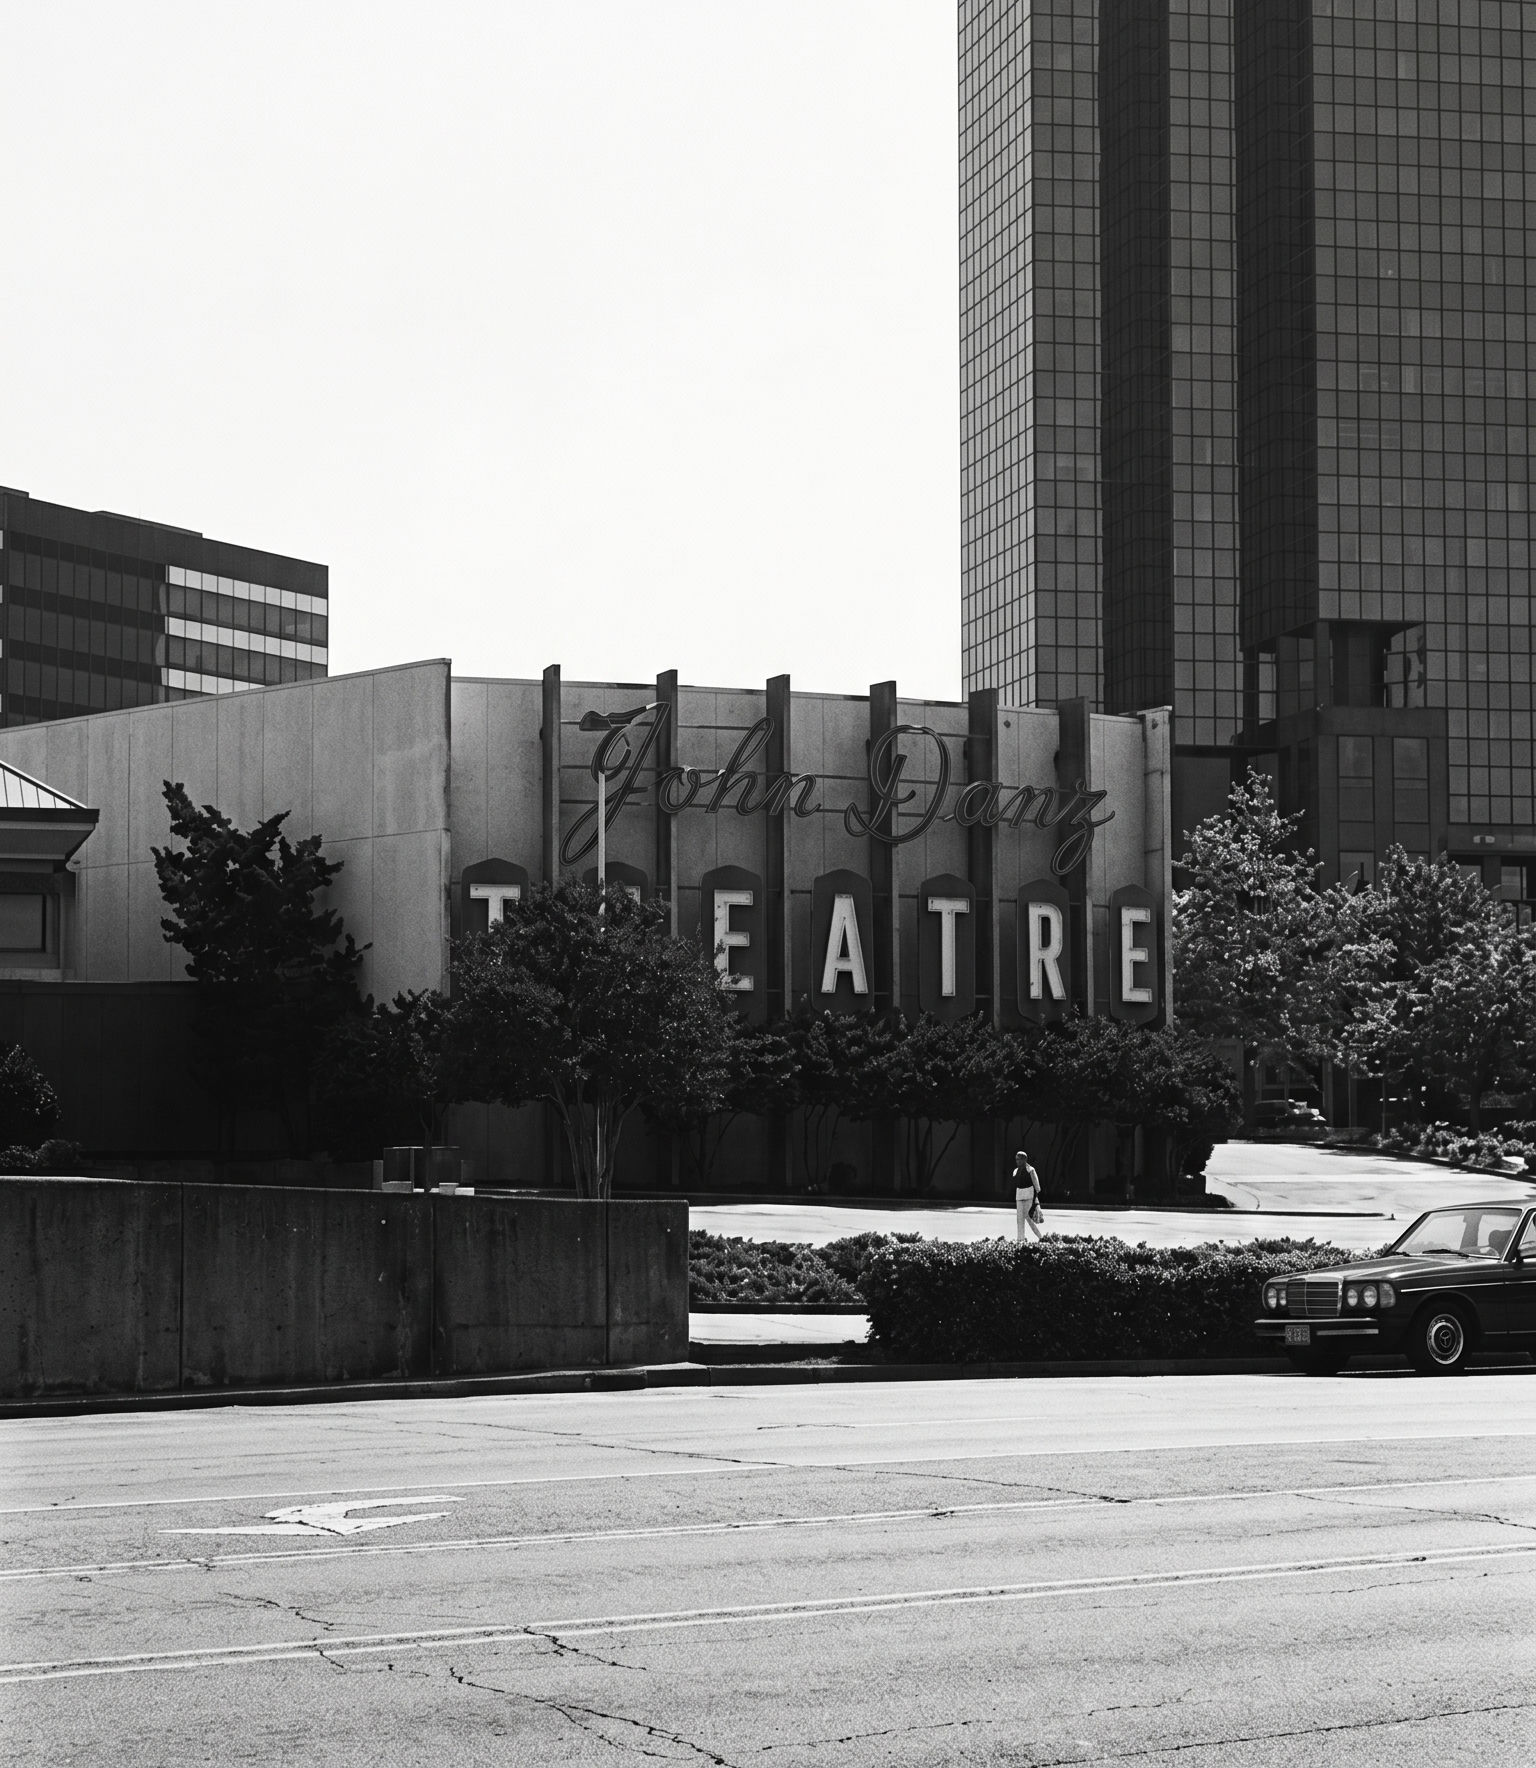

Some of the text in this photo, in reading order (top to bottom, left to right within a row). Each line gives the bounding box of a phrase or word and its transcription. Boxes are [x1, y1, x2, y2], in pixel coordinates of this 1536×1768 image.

[560, 701, 1116, 876] John Danz
[469, 883, 1153, 1003] TEATRE
